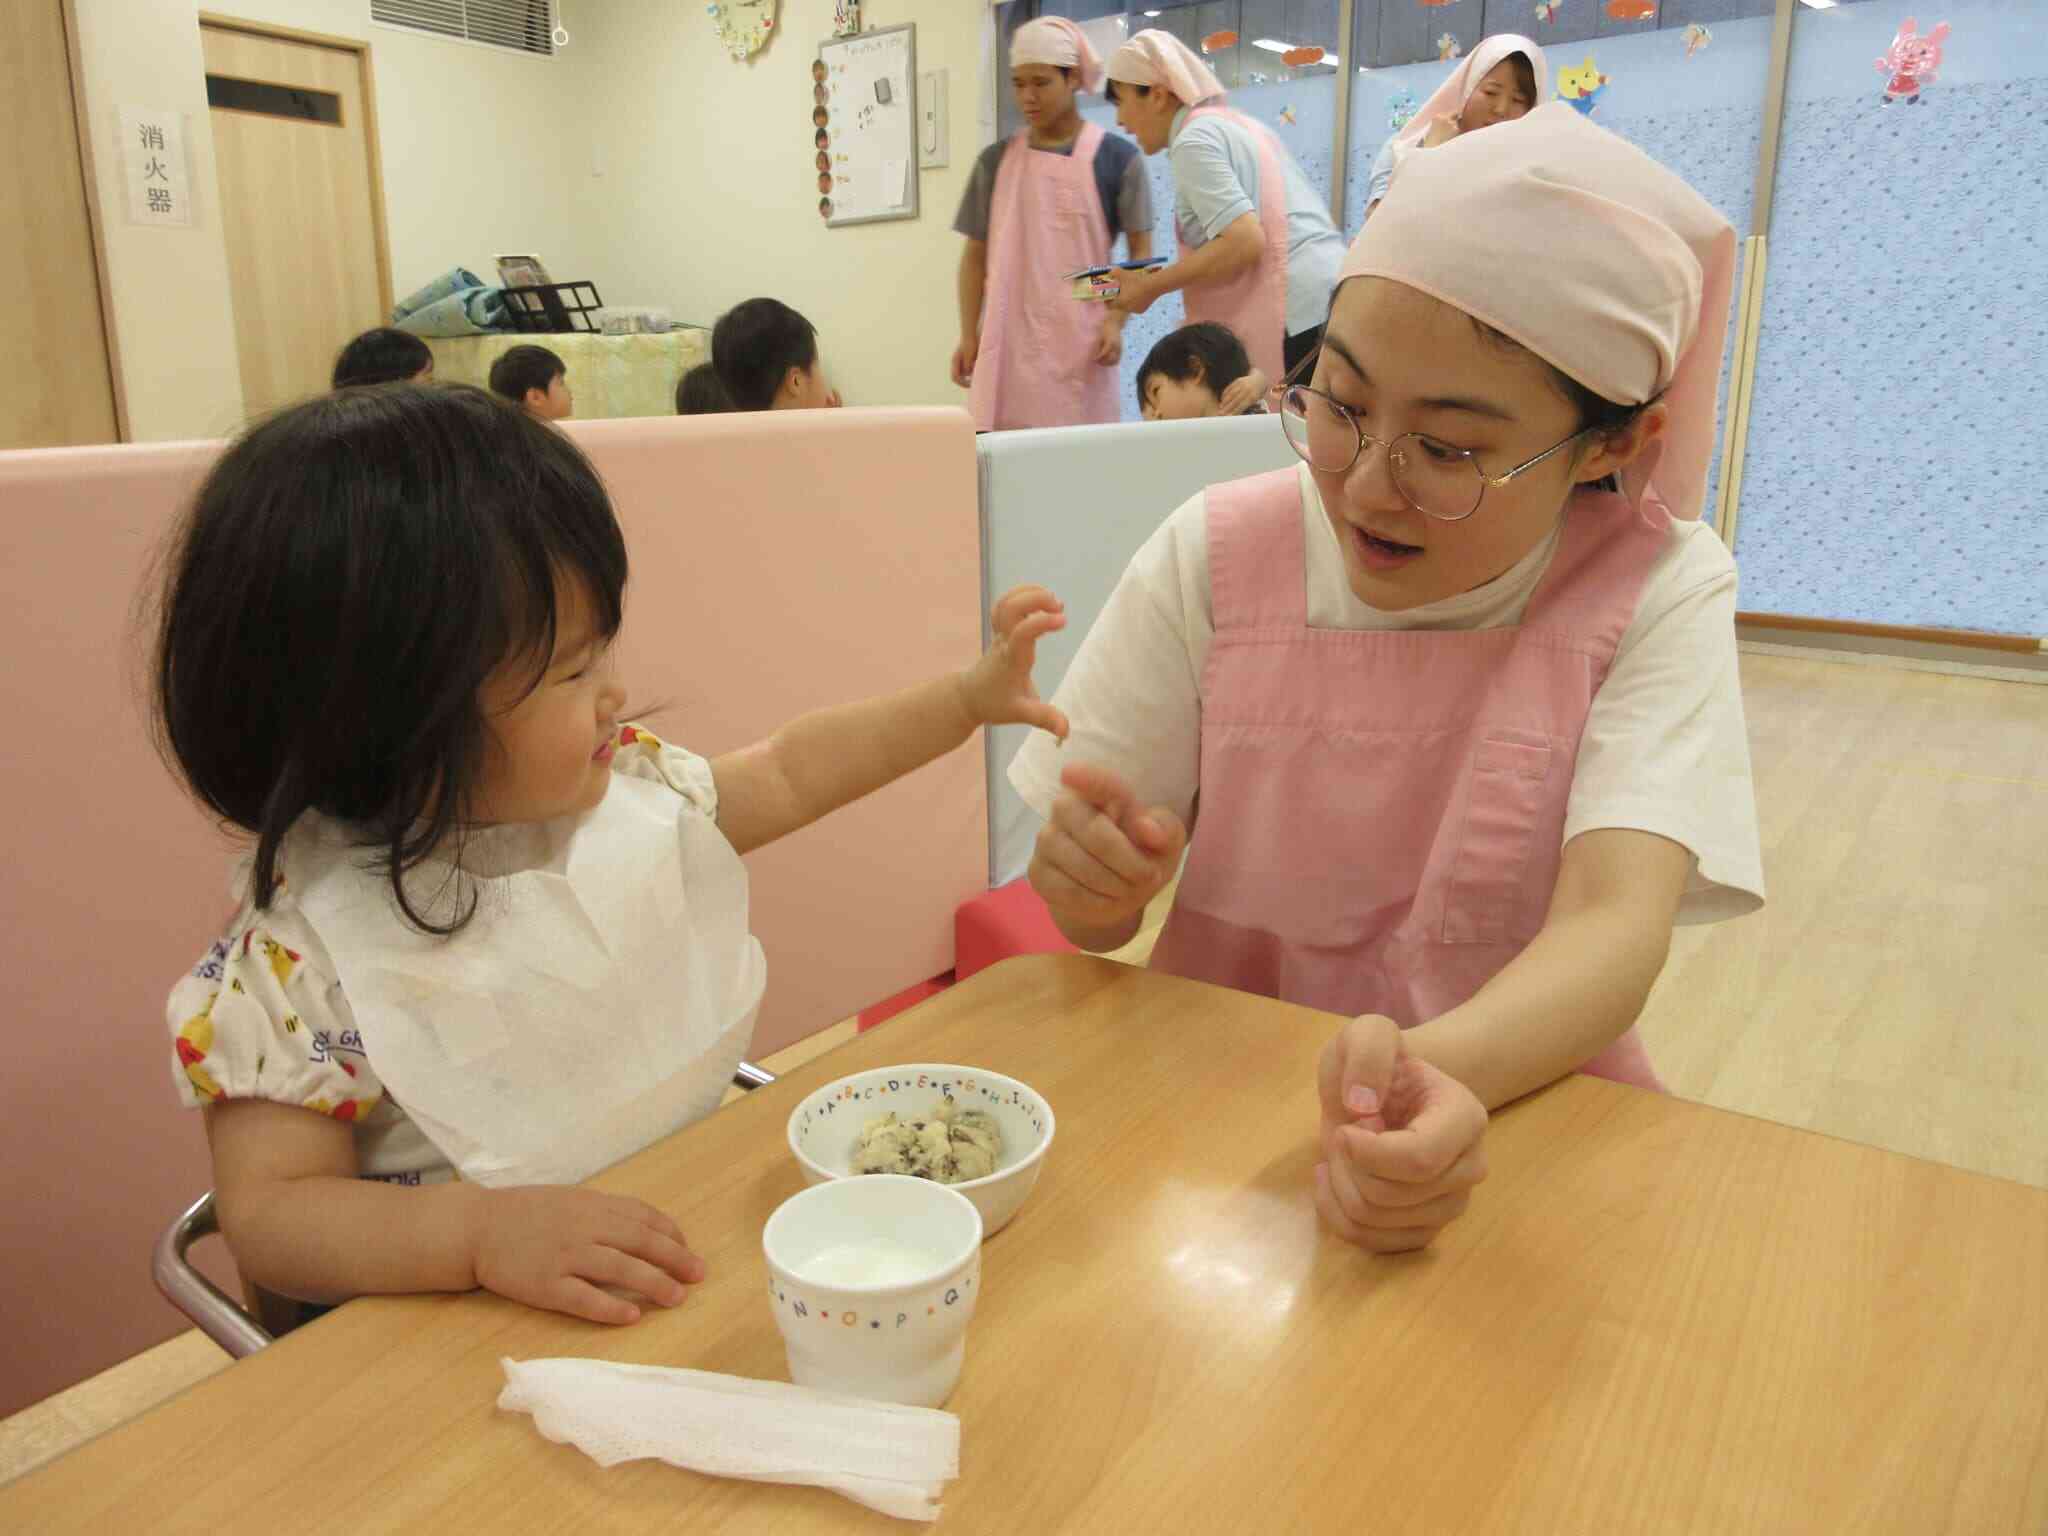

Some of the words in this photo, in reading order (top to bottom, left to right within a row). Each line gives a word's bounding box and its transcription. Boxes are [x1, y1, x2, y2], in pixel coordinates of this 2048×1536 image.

[138, 122, 172, 213] 消火器
[827, 1101, 836, 1114] A
[864, 1087, 873, 1100] C
[887, 1079, 900, 1092] D
[917, 1074, 929, 1089] E
[942, 1083, 951, 1097] F
[990, 1090, 1000, 1105] H
[793, 1300, 808, 1319] N
[841, 1311, 857, 1327] O
[896, 1312, 907, 1328] P
[944, 1288, 959, 1306] Q
